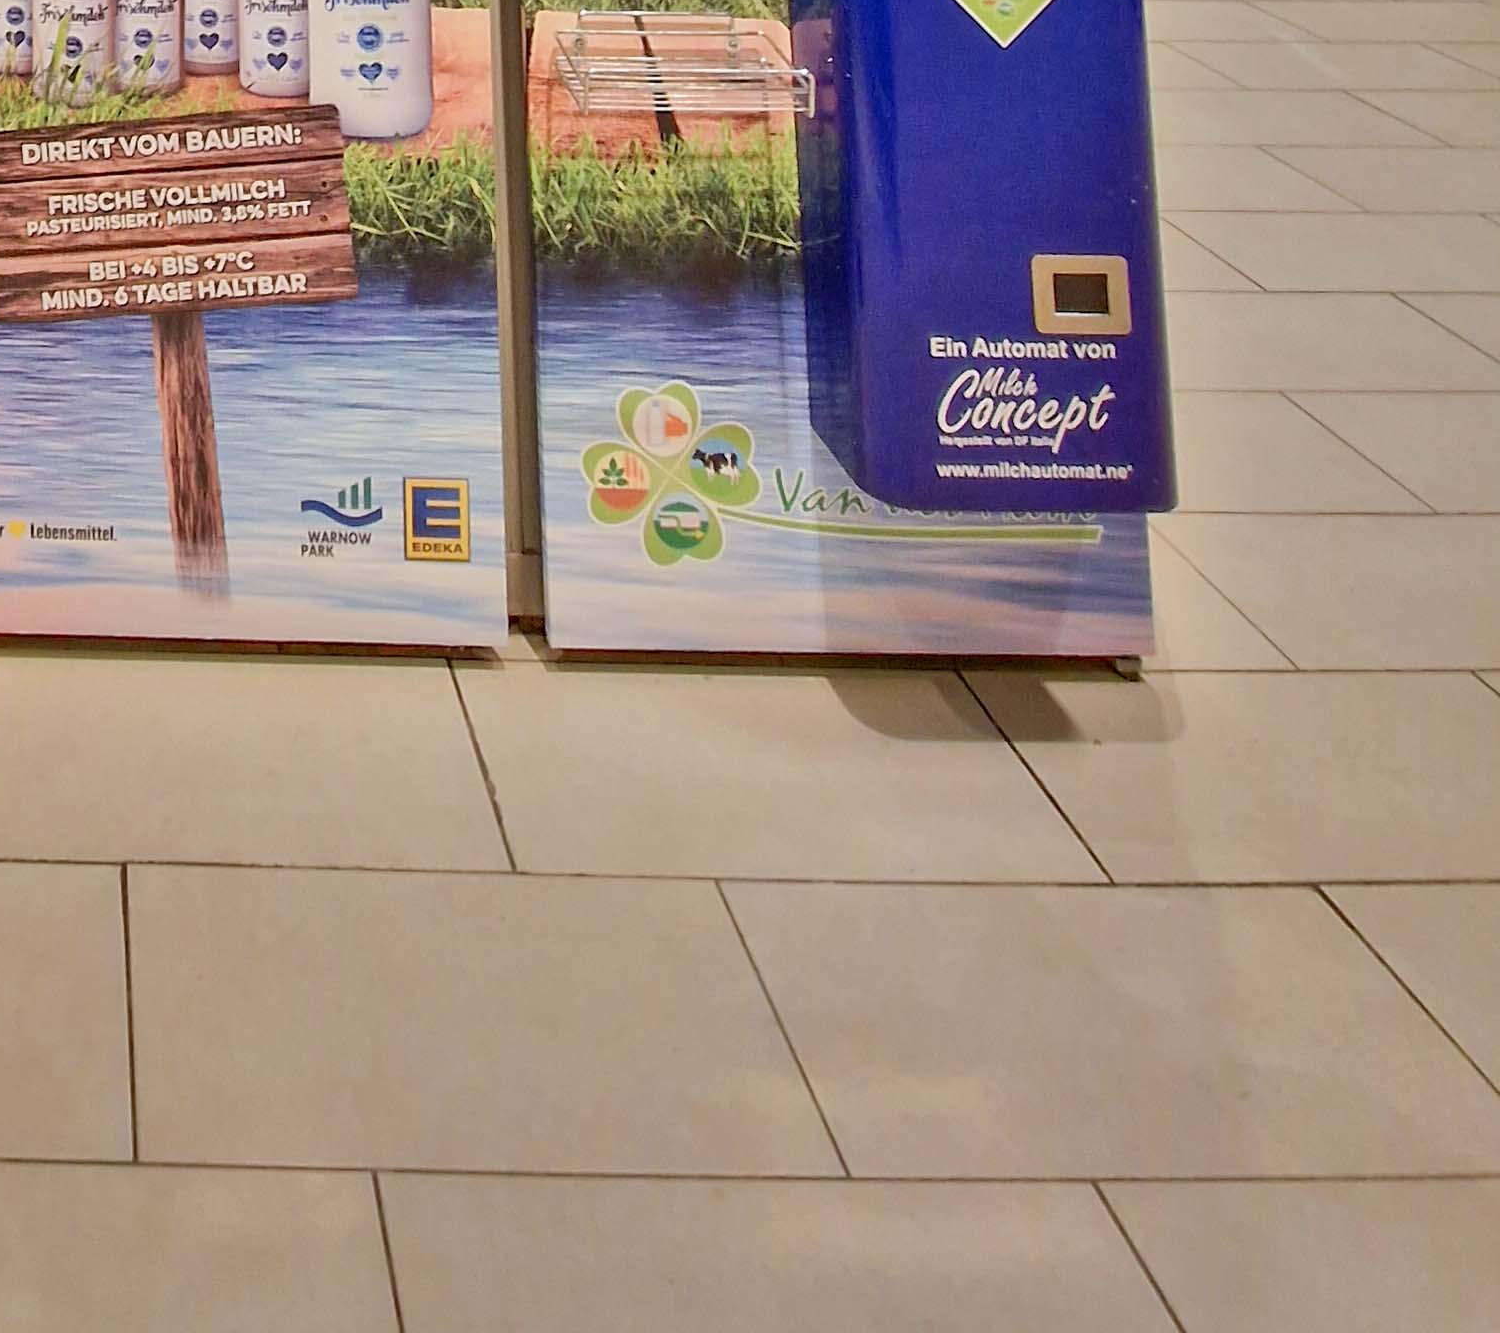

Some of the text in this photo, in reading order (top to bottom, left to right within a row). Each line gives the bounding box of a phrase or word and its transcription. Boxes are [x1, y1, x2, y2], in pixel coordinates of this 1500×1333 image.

[22, 123, 302, 165] DIREKT VOM BAUERN:
[48, 179, 286, 215] FRISCHE VOLLMILCH
[27, 199, 311, 237] PASTEURISIERT, MIND. 3,8% FETT
[89, 251, 255, 282] BEI +4 BIS +7°C
[41, 272, 309, 312] MIND. 6 TAGE HALTBAR
[930, 337, 1117, 359] Ein Automat von
[976, 366, 1038, 398] Milch
[937, 369, 1116, 454] Concept
[936, 462, 1133, 479] www.milchautomat.ne
[775, 468, 870, 516] Van
[412, 486, 462, 538] E
[30, 523, 118, 542] Lebensmittel.
[307, 530, 372, 545] WARNOW
[411, 542, 463, 555] EDEKA
[301, 544, 334, 558] PARK
